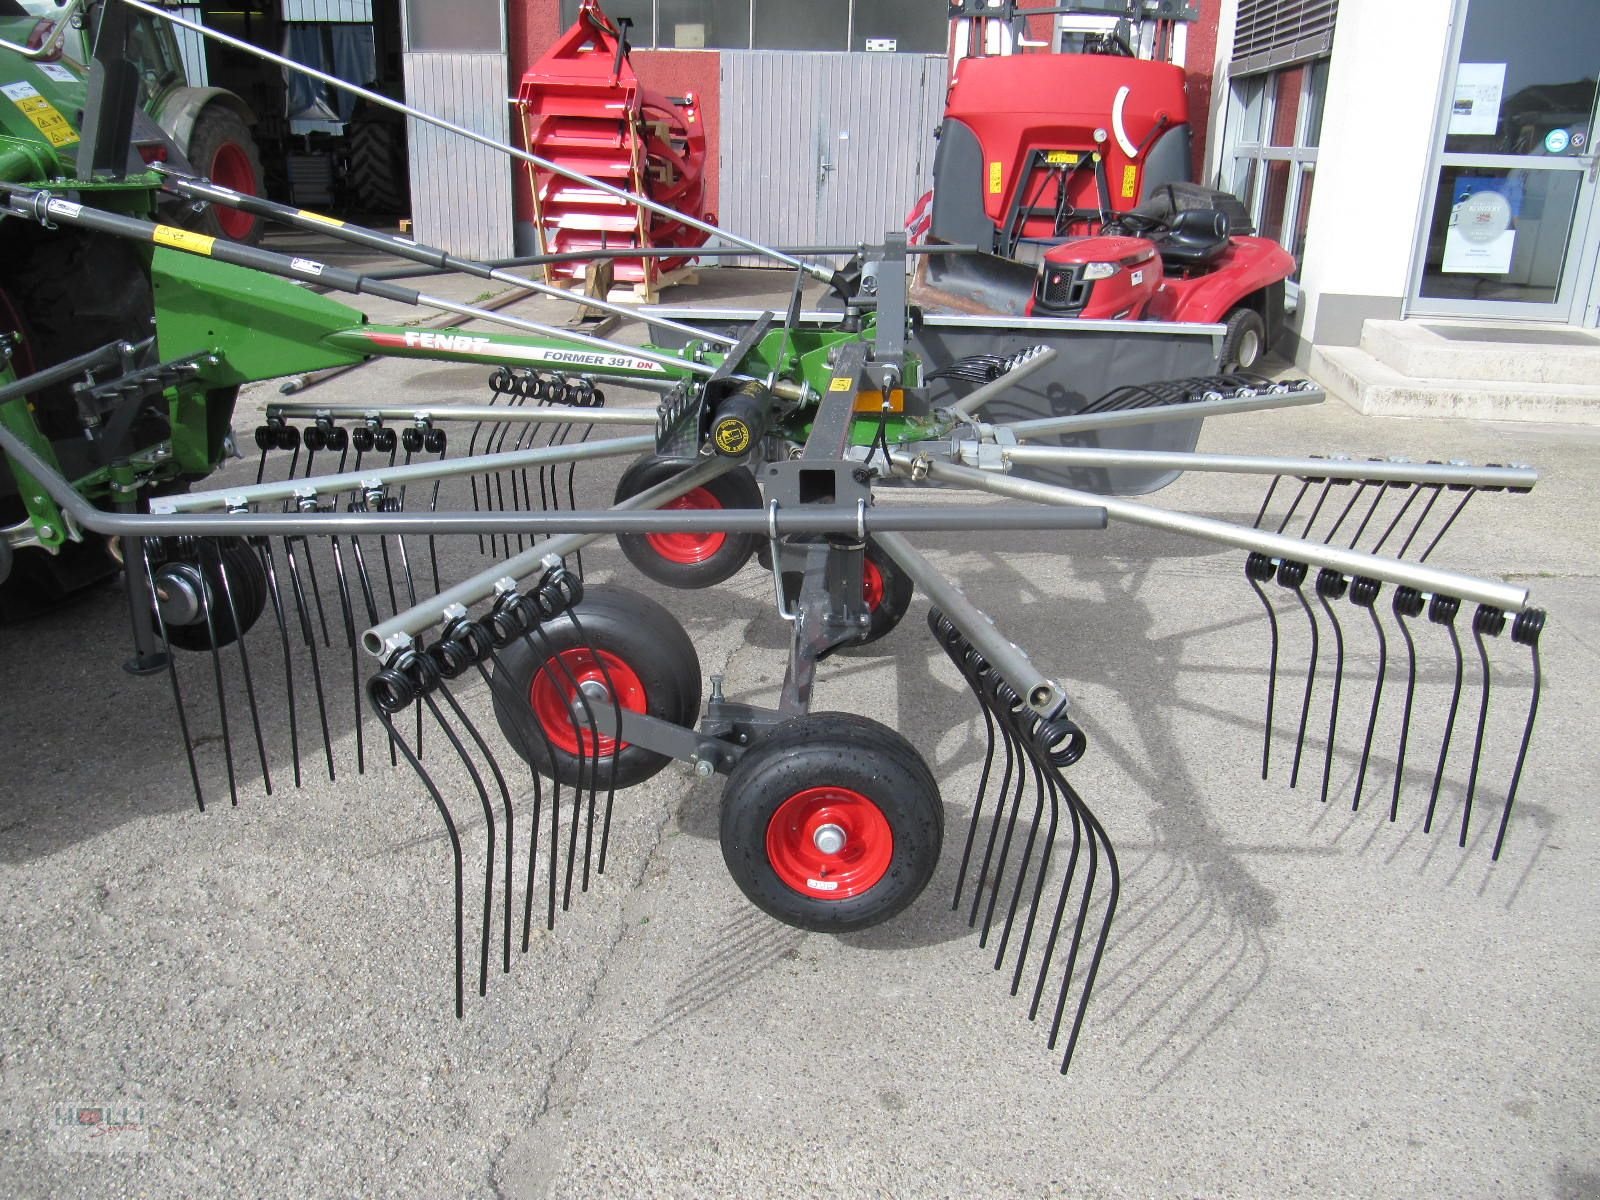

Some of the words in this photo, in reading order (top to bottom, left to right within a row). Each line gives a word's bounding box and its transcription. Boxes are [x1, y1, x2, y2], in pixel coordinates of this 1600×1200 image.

[404, 331, 490, 353] FENDT
[543, 351, 604, 365] FORMER
[607, 356, 634, 368] 391
[636, 361, 654, 370] DN
